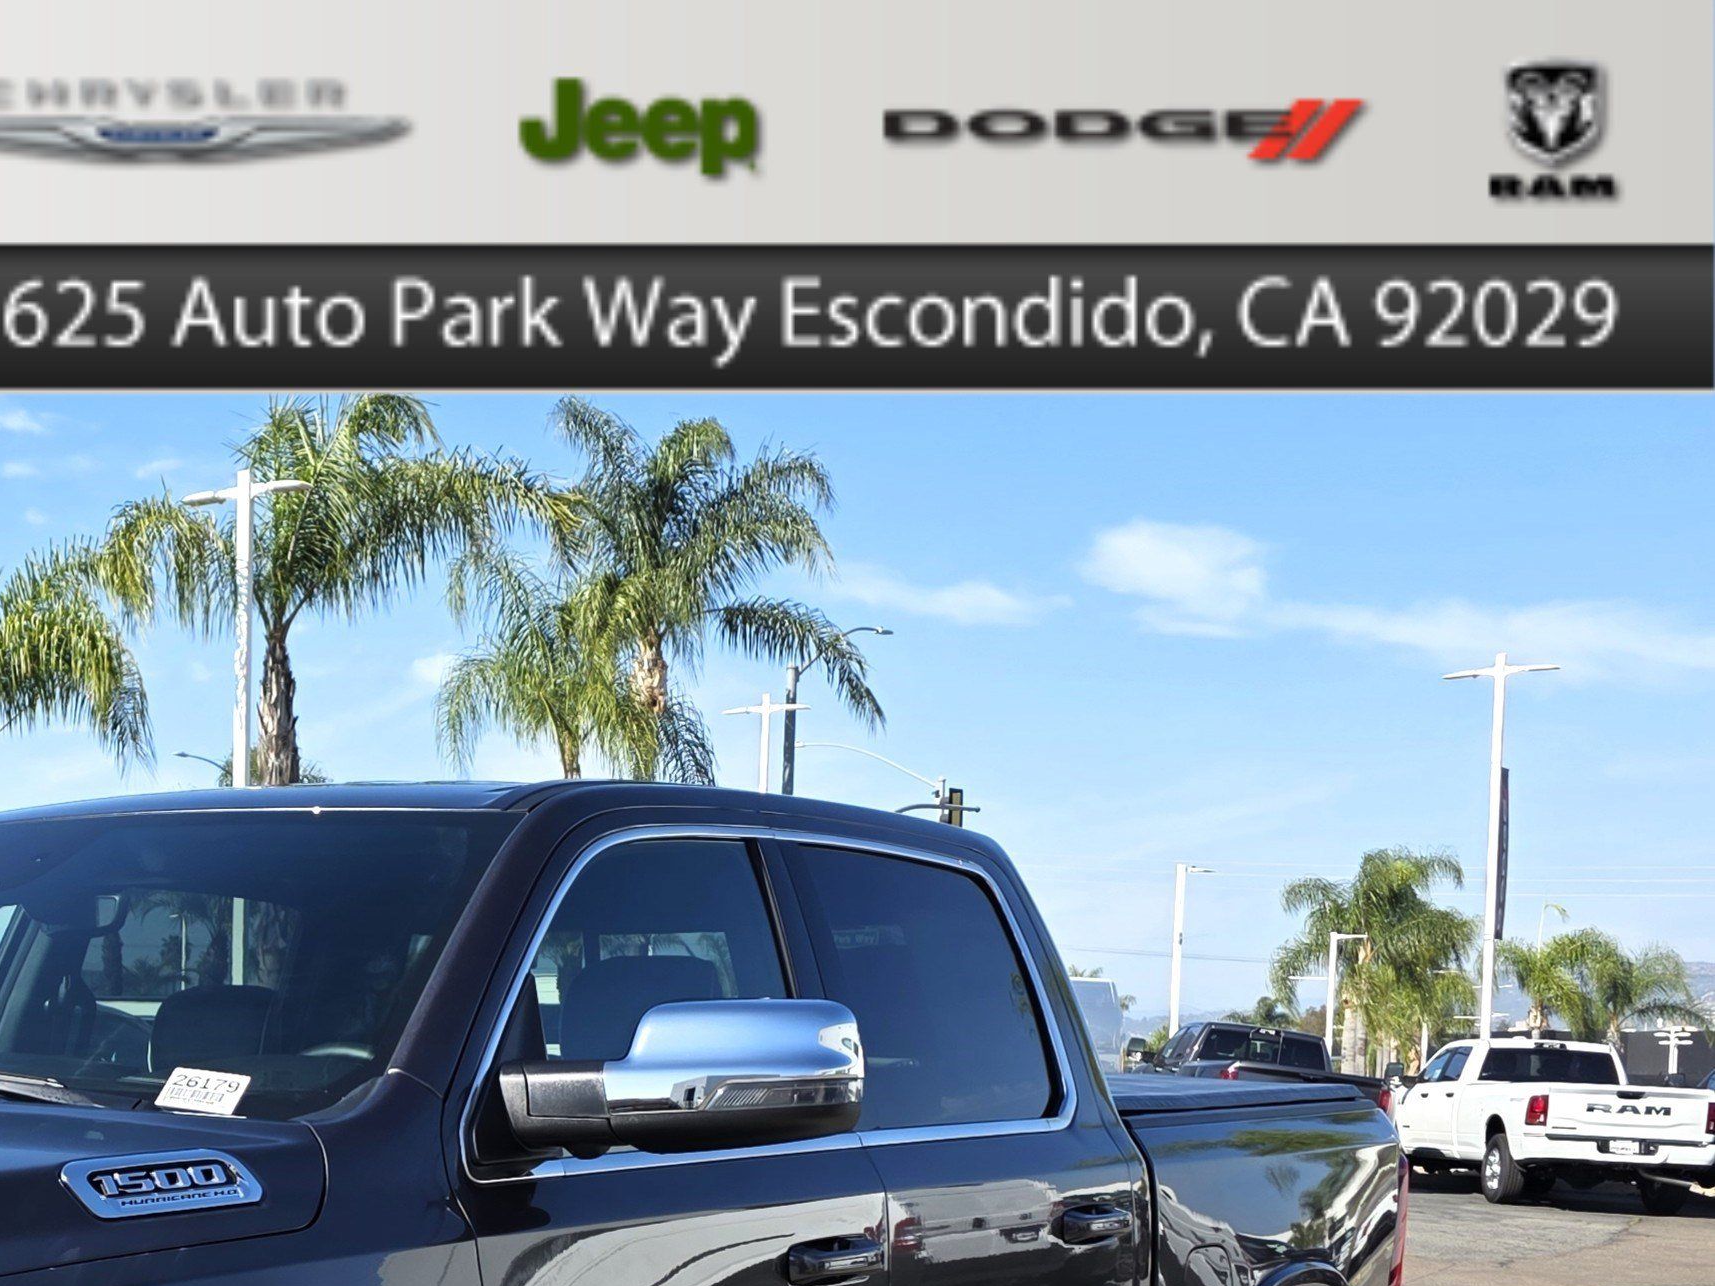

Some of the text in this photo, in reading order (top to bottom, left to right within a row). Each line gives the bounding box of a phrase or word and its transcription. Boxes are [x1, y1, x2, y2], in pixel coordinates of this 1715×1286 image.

[173, 1074, 240, 1093] 26179
[1586, 1103, 1672, 1116] RAM
[92, 1164, 227, 1196] 1500
[121, 1190, 212, 1206] HURRICANE
